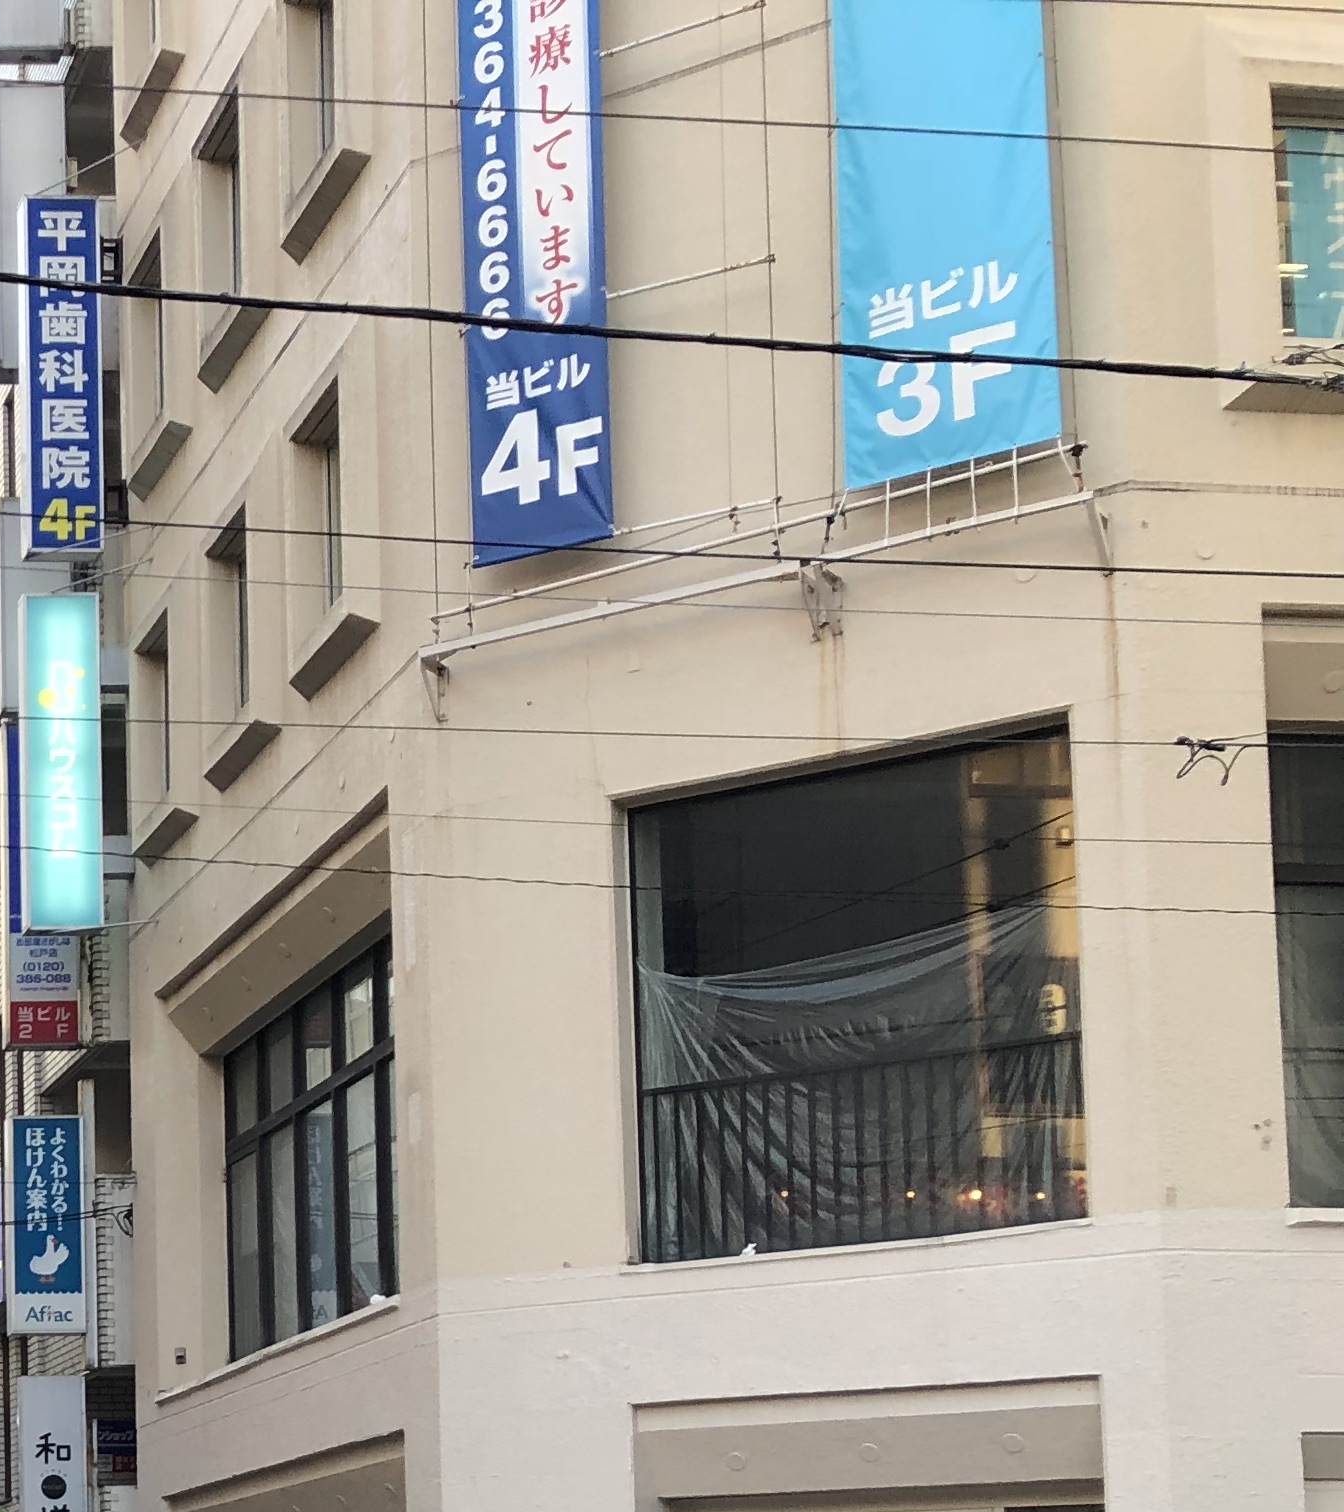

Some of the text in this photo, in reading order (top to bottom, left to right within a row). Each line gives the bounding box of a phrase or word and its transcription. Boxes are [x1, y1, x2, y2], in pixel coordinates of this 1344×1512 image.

[868, 260, 1018, 340] 当ビル
[38, 210, 91, 490] 平岡歯科医院
[484, 354, 590, 411] 当ビル
[876, 321, 1016, 438] 3F
[481, 410, 602, 506] 4F
[39, 497, 95, 542] 4F
[23, 961, 65, 972] (0120)
[18, 1006, 71, 1022] 当ビル
[25, 1127, 48, 1232] ほけん案内
[25, 1305, 74, 1323] Aflac
[35, 1432, 71, 1464] 和
